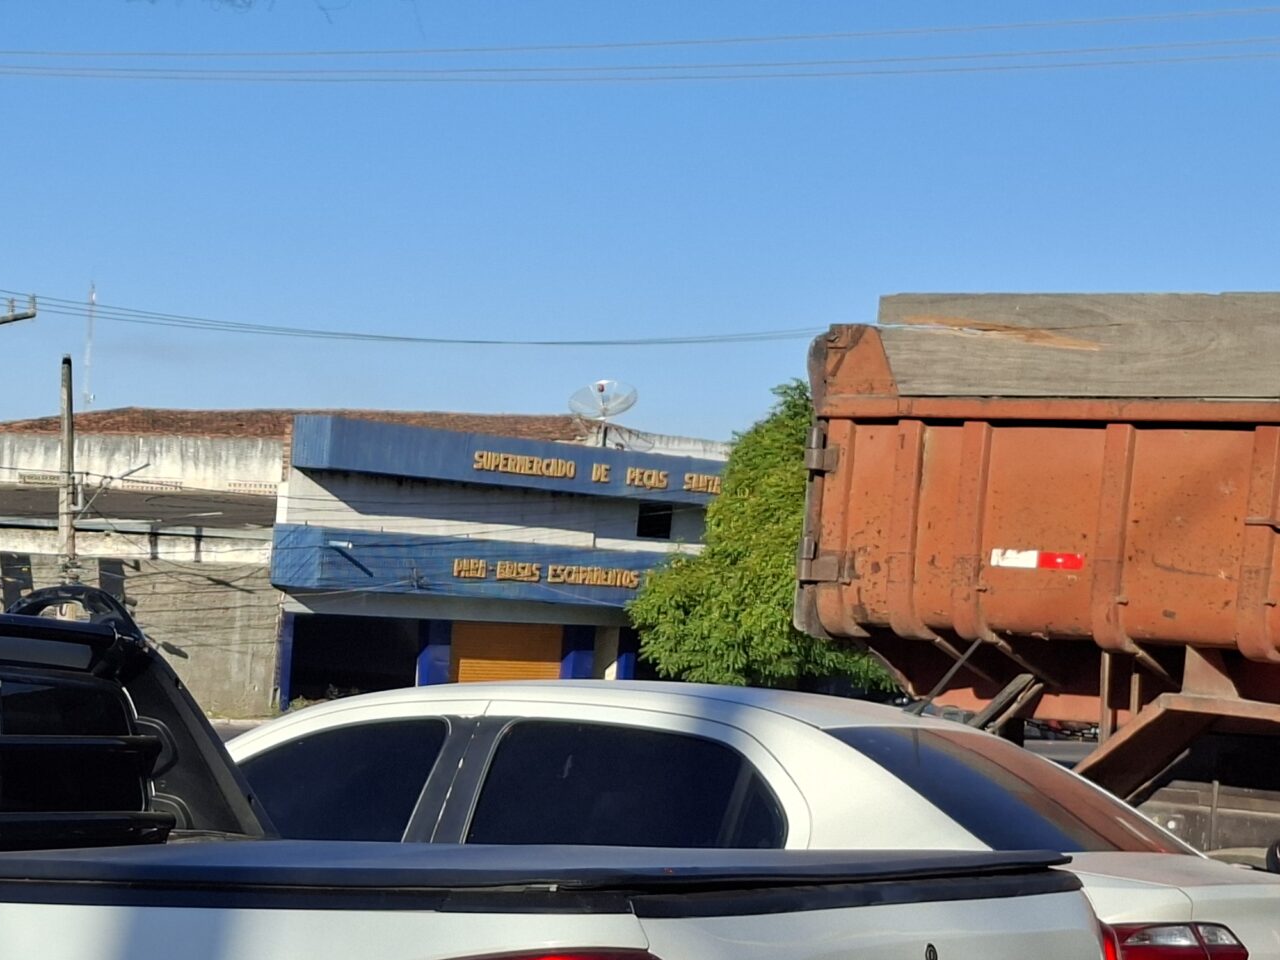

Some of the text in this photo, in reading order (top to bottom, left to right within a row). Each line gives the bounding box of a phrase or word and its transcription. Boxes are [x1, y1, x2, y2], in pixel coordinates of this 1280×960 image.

[473, 450, 577, 479] SUPERMERCADO
[591, 463, 610, 483] DE
[626, 467, 669, 490] PEÇAS
[547, 564, 640, 589] ESCAPAMENTOS
